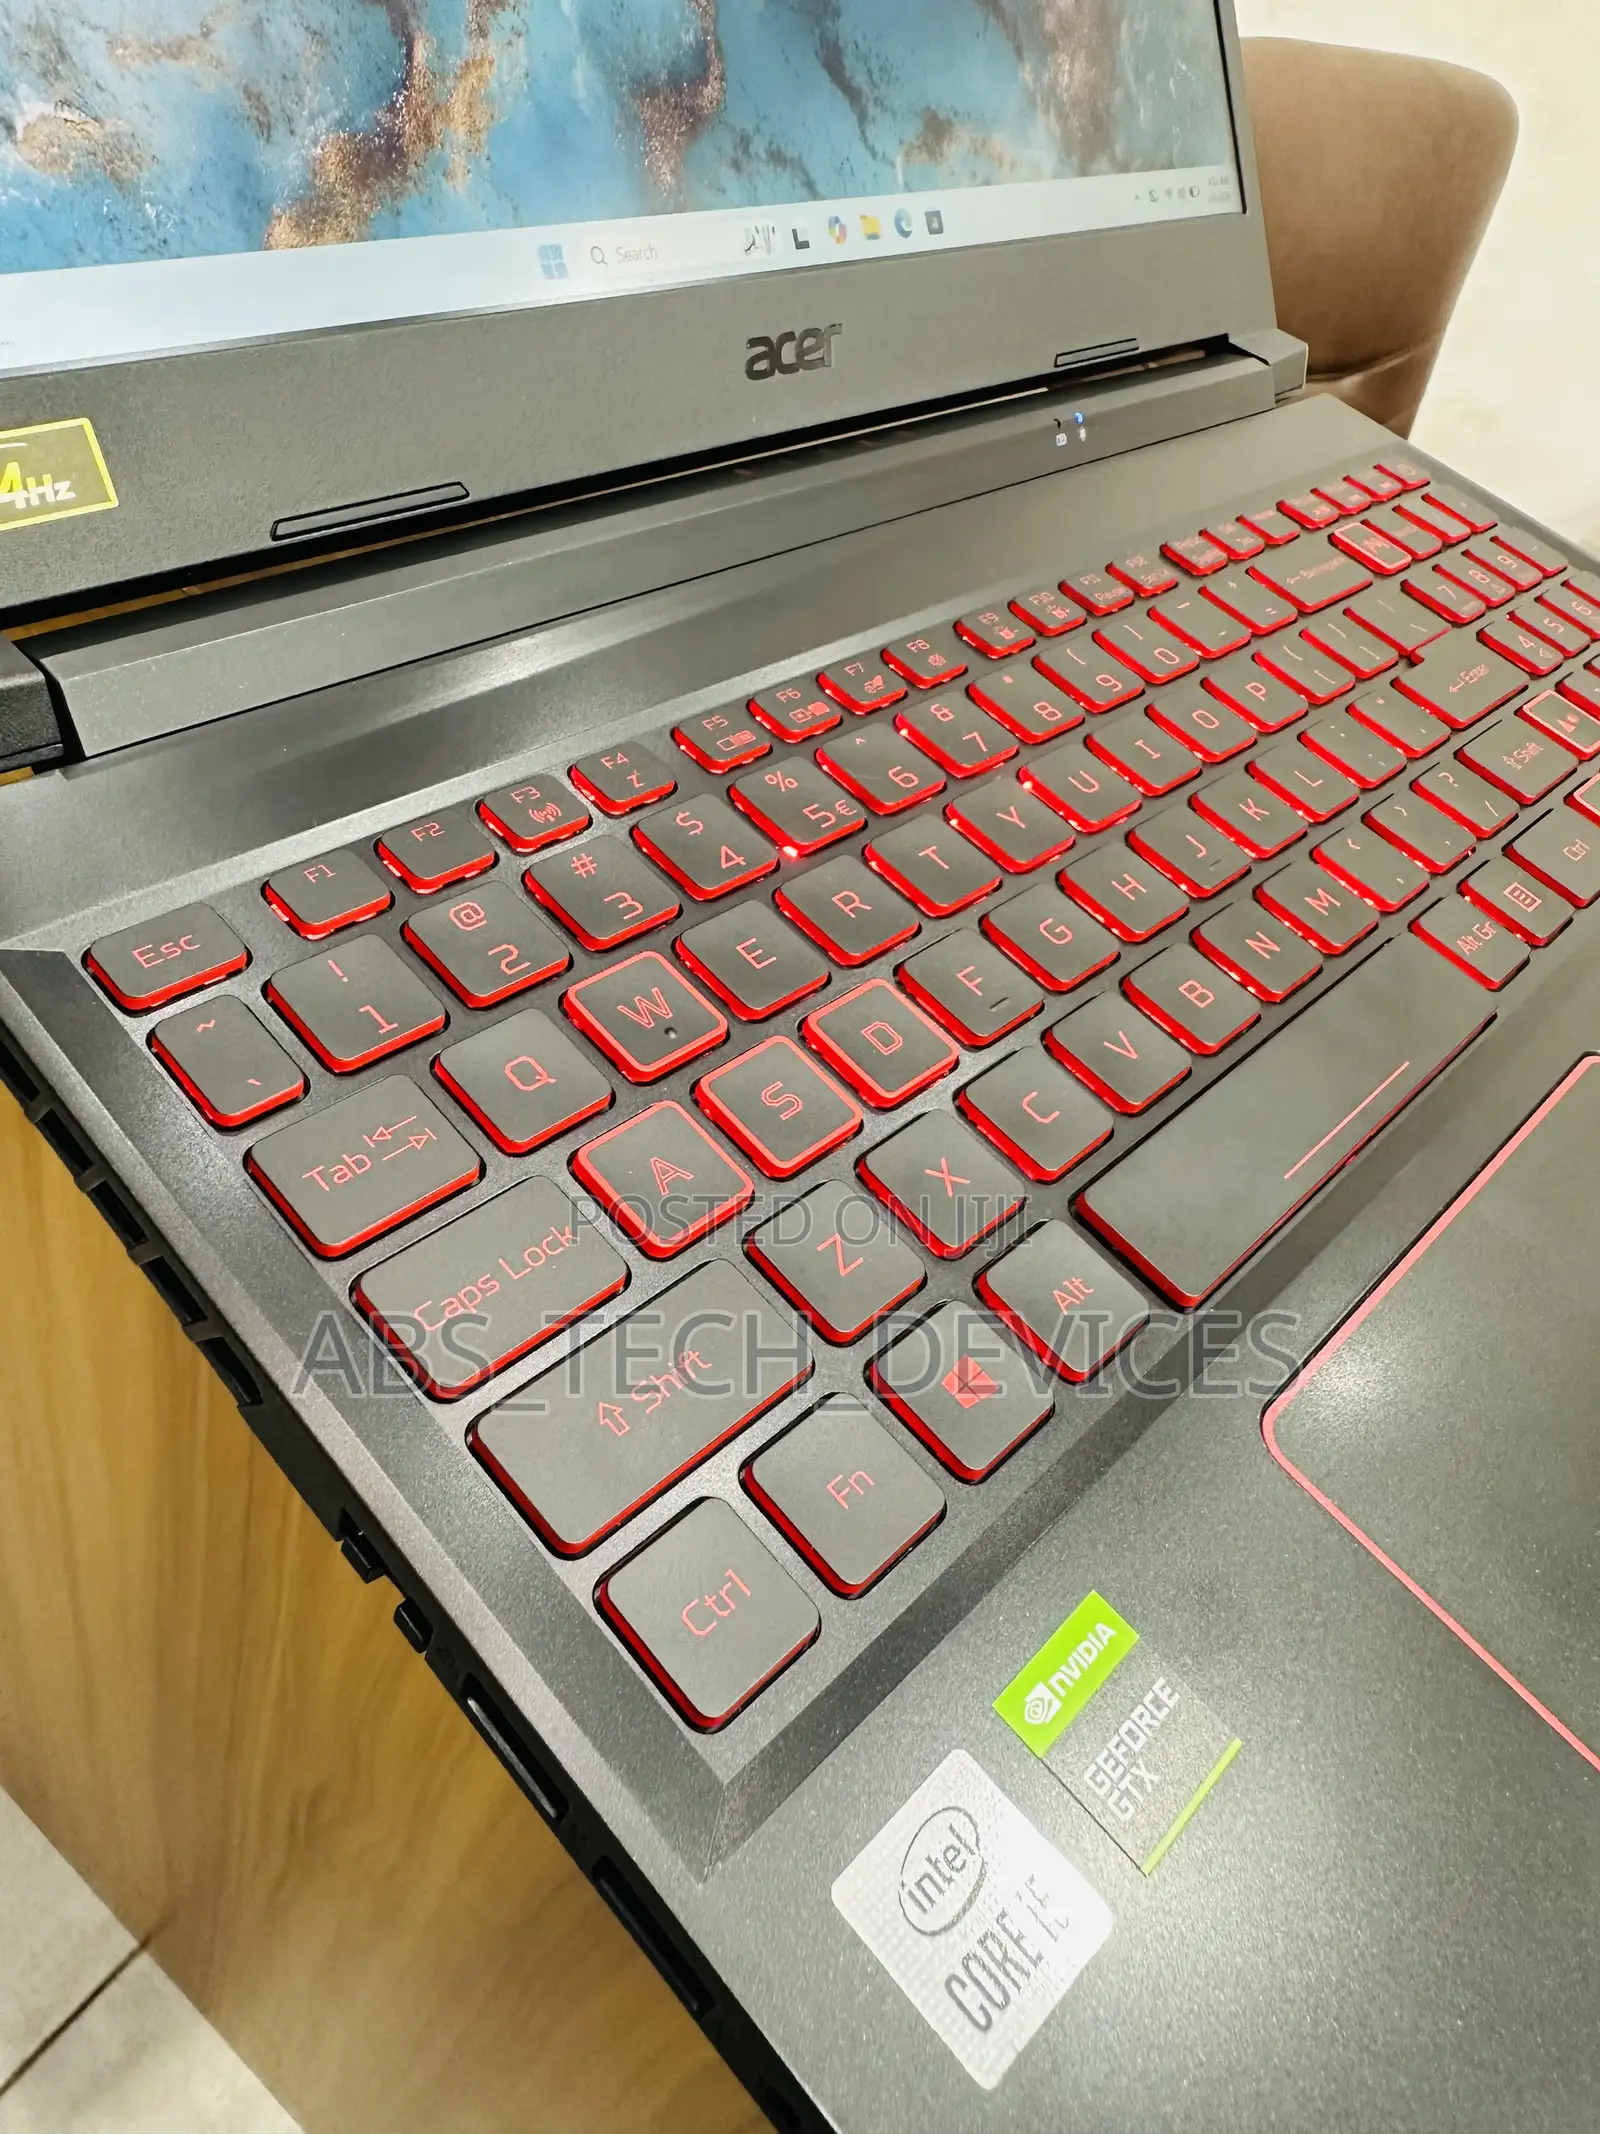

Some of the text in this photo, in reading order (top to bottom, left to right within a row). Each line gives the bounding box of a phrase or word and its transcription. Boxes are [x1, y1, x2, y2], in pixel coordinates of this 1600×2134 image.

[615, 242, 658, 263] Search
[745, 323, 843, 380] acer
[843, 662, 865, 676] F7
[1095, 673, 1123, 693] 9
[777, 688, 801, 701] F6
[1245, 681, 1267, 702] P
[702, 715, 729, 731] F5
[1033, 701, 1063, 721] 8
[962, 731, 989, 753] 7
[1134, 738, 1161, 760] I
[600, 752, 630, 770] F4
[765, 772, 798, 792] %
[887, 766, 920, 788] 6
[1070, 772, 1100, 794] U
[1293, 770, 1324, 788] L
[510, 786, 541, 803] F3
[676, 811, 704, 834] $
[998, 806, 1026, 828] Y
[1238, 797, 1271, 822] K
[411, 822, 443, 841] F2
[719, 845, 747, 869] 4
[920, 846, 948, 868] T
[1187, 835, 1208, 858] J
[304, 864, 335, 882] F1
[572, 854, 596, 877] #
[1111, 872, 1148, 901] H
[449, 902, 485, 930] @
[604, 890, 645, 920] 3
[832, 890, 871, 917] R
[1303, 887, 1343, 917] M
[1038, 919, 1073, 945] G
[1244, 930, 1282, 960] N
[1456, 920, 1498, 956] Alt Gr
[131, 934, 200, 969] Esc
[487, 943, 532, 976] 2
[735, 937, 778, 970] E
[328, 960, 347, 980] !
[956, 964, 985, 997] F
[616, 986, 675, 1029] W
[1178, 980, 1215, 1007] B
[358, 1004, 399, 1035] 1
[861, 1022, 903, 1055] D
[1104, 1031, 1139, 1059] V
[504, 1056, 555, 1091] Q
[761, 1081, 803, 1120] S
[1021, 1091, 1060, 1124] C
[305, 1154, 372, 1191] Tab
[650, 1157, 692, 1196] A
[924, 1156, 972, 1198] X
[817, 1233, 863, 1276] Z
[412, 1224, 582, 1333] Caps Lock
[1053, 1277, 1094, 1314] Alt
[631, 1351, 712, 1414] Shift
[826, 1471, 873, 1509] Fn
[681, 1569, 751, 1637] Ctrl
[1083, 1676, 1181, 1797] GEFORCE
[1107, 1762, 1162, 1823] GTX
[905, 1820, 981, 1917] intel
[943, 1908, 1046, 2034] CORE
